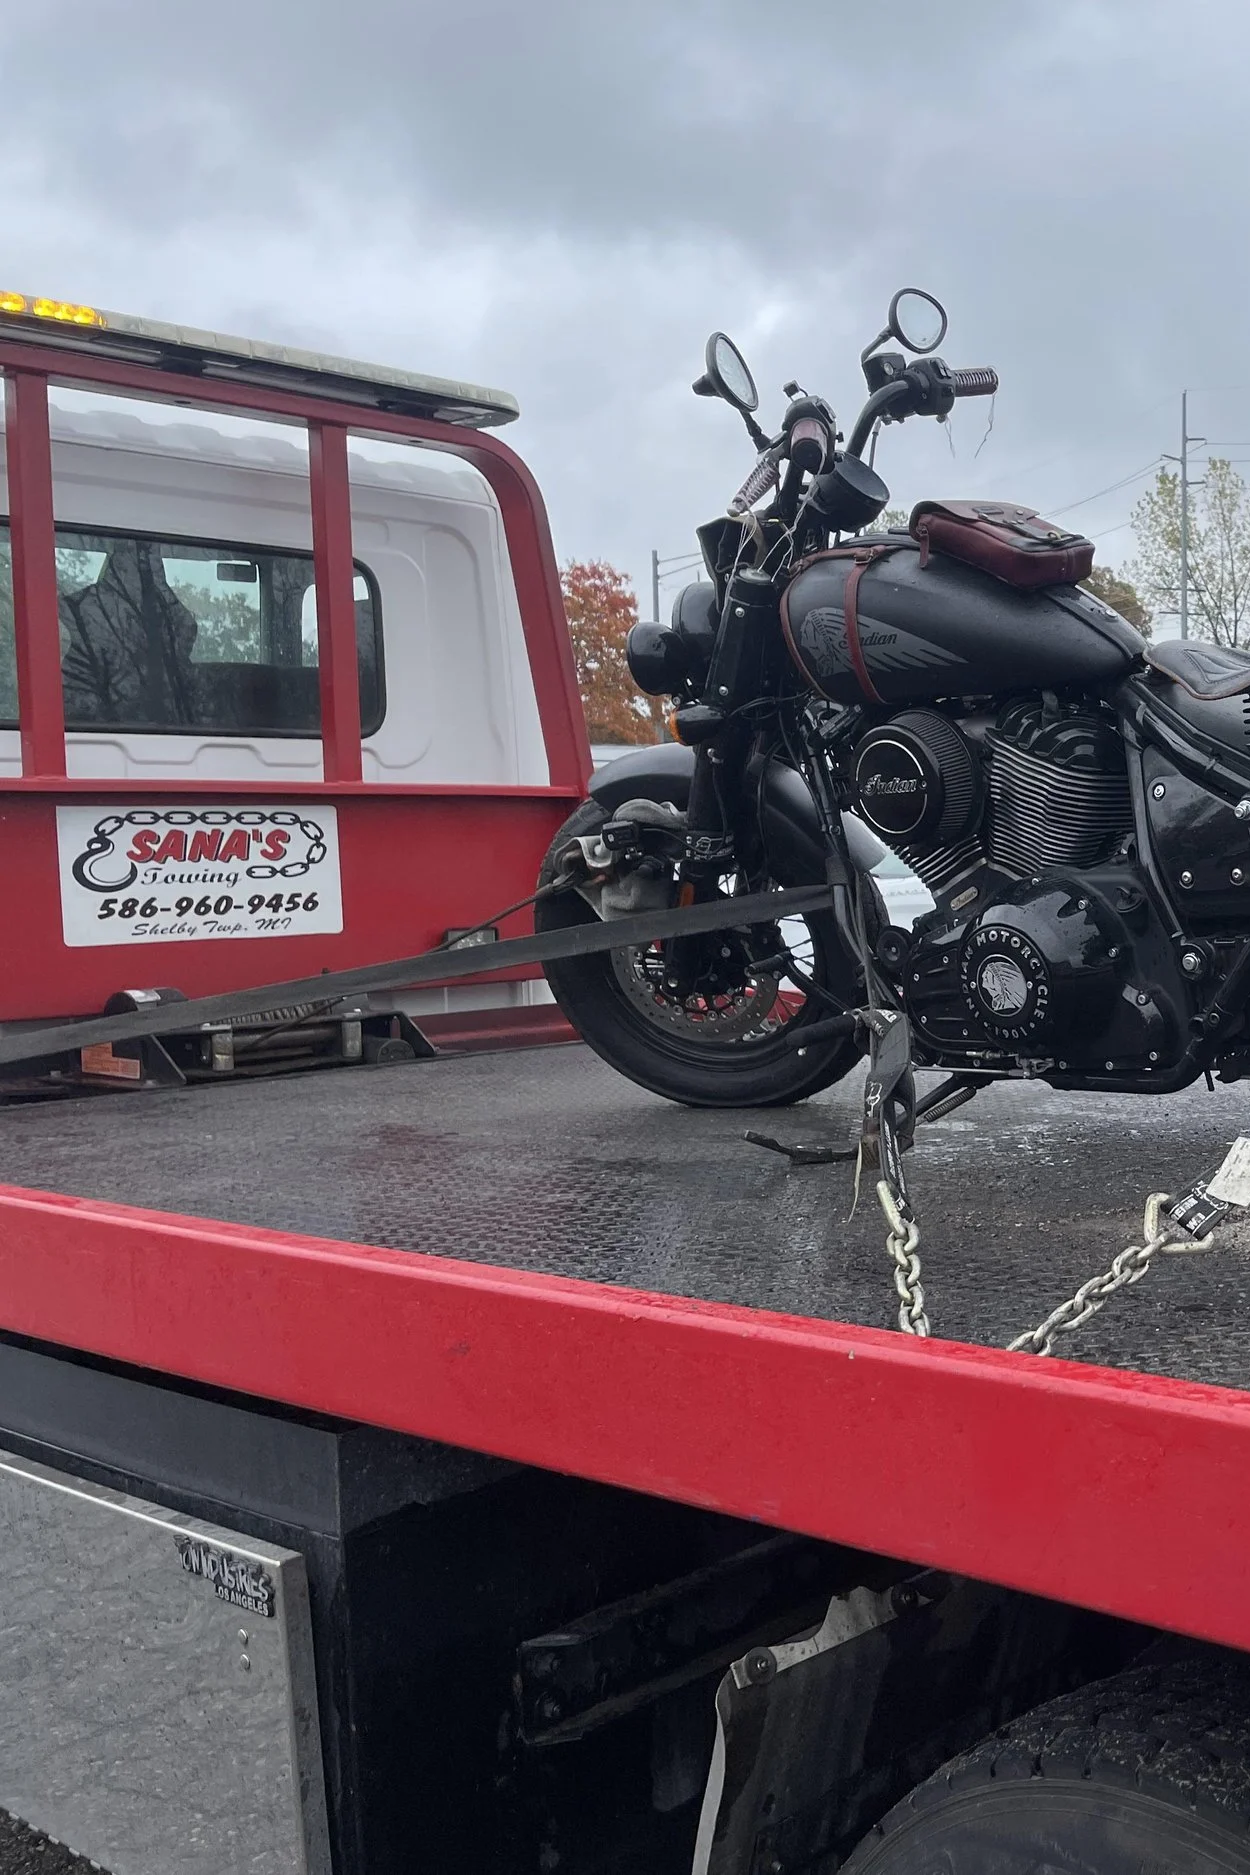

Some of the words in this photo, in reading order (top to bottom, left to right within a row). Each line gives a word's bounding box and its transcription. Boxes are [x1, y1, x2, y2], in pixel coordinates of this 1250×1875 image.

[864, 774, 917, 796] Indian
[126, 828, 291, 864] SANA'S
[141, 867, 241, 888] Towing
[97, 892, 320, 919] 586-960-9456
[132, 922, 197, 937] Shelby
[203, 920, 248, 934] Twp.
[255, 917, 292, 931] MI
[961, 945, 980, 1018] INDIAN
[976, 930, 1048, 1019] MOTORCYCLE
[995, 1026, 1028, 1039] 1901
[230, 1590, 268, 1616] ANGELES
